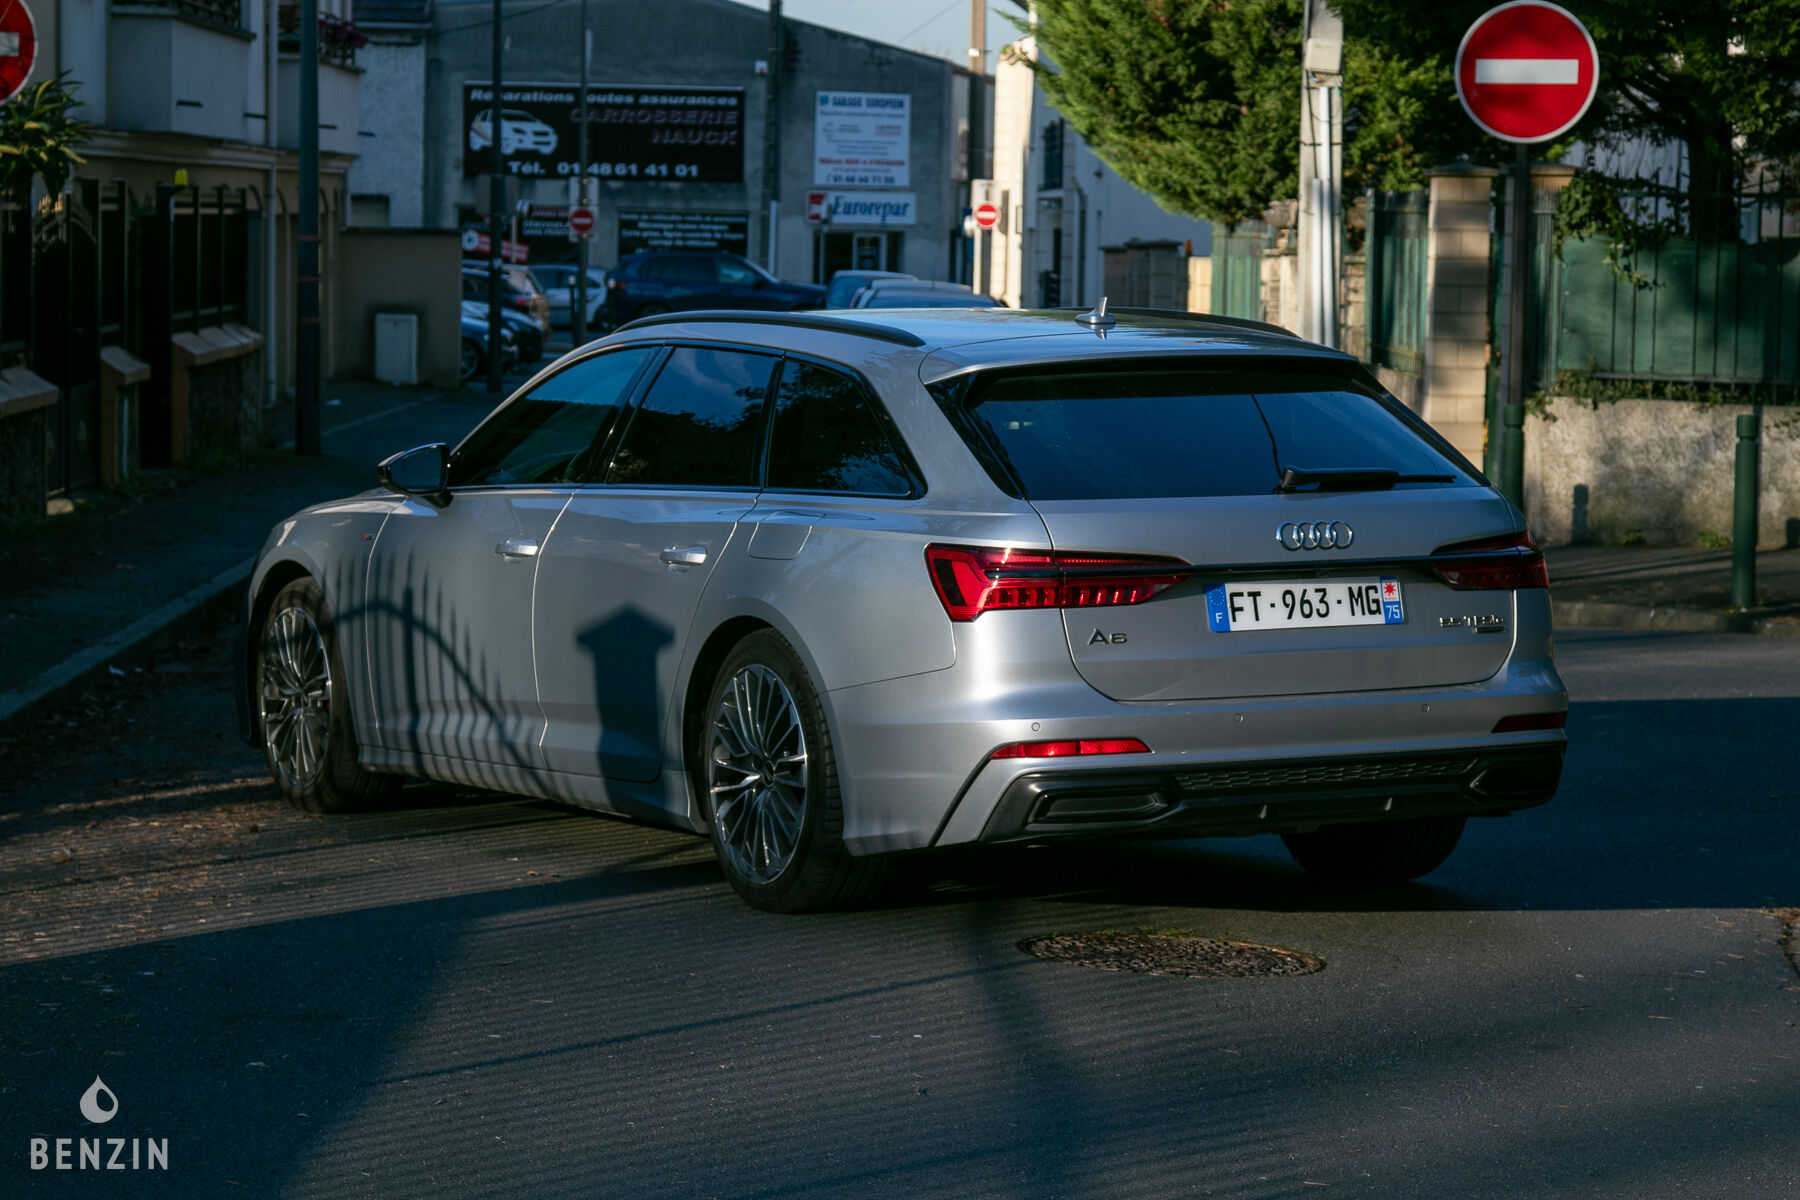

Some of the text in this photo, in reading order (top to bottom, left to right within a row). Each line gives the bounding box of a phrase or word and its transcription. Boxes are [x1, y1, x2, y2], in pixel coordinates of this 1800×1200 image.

[470, 89, 738, 106] Réarations outes assurances
[570, 107, 738, 125] CARROSSERIE
[507, 161, 699, 178] Tél. 01 48 61 41 01
[832, 194, 910, 222] Eurorepar
[1215, 612, 1223, 624] F
[1386, 604, 1400, 619] 75
[1087, 627, 1128, 646] A6
